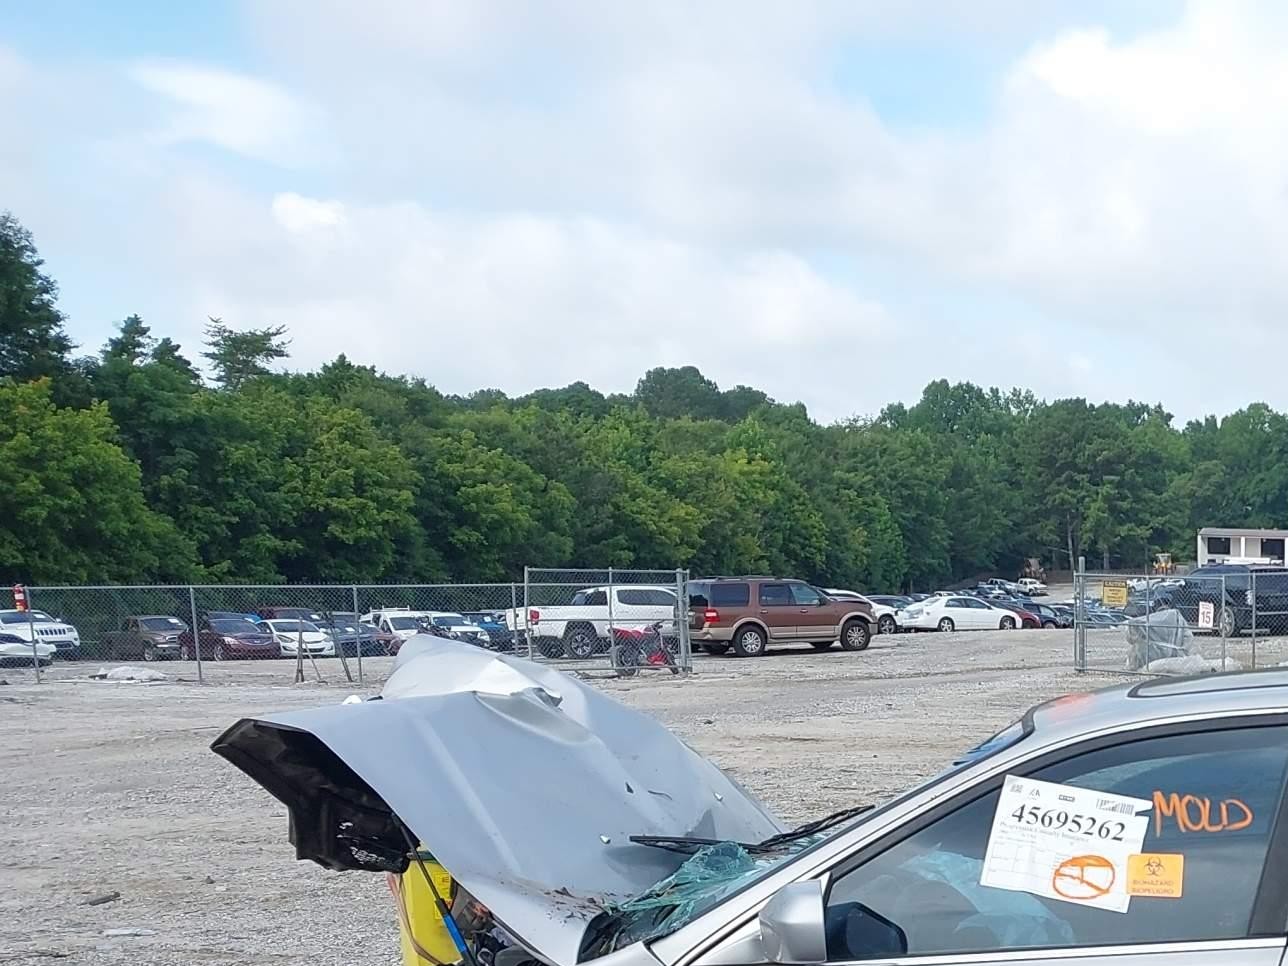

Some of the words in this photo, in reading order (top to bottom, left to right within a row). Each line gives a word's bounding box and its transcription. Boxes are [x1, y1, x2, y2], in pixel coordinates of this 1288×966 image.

[1201, 611, 1212, 624] 15
[1011, 803, 1126, 842] 45695262
[1152, 790, 1254, 839] MOLD
